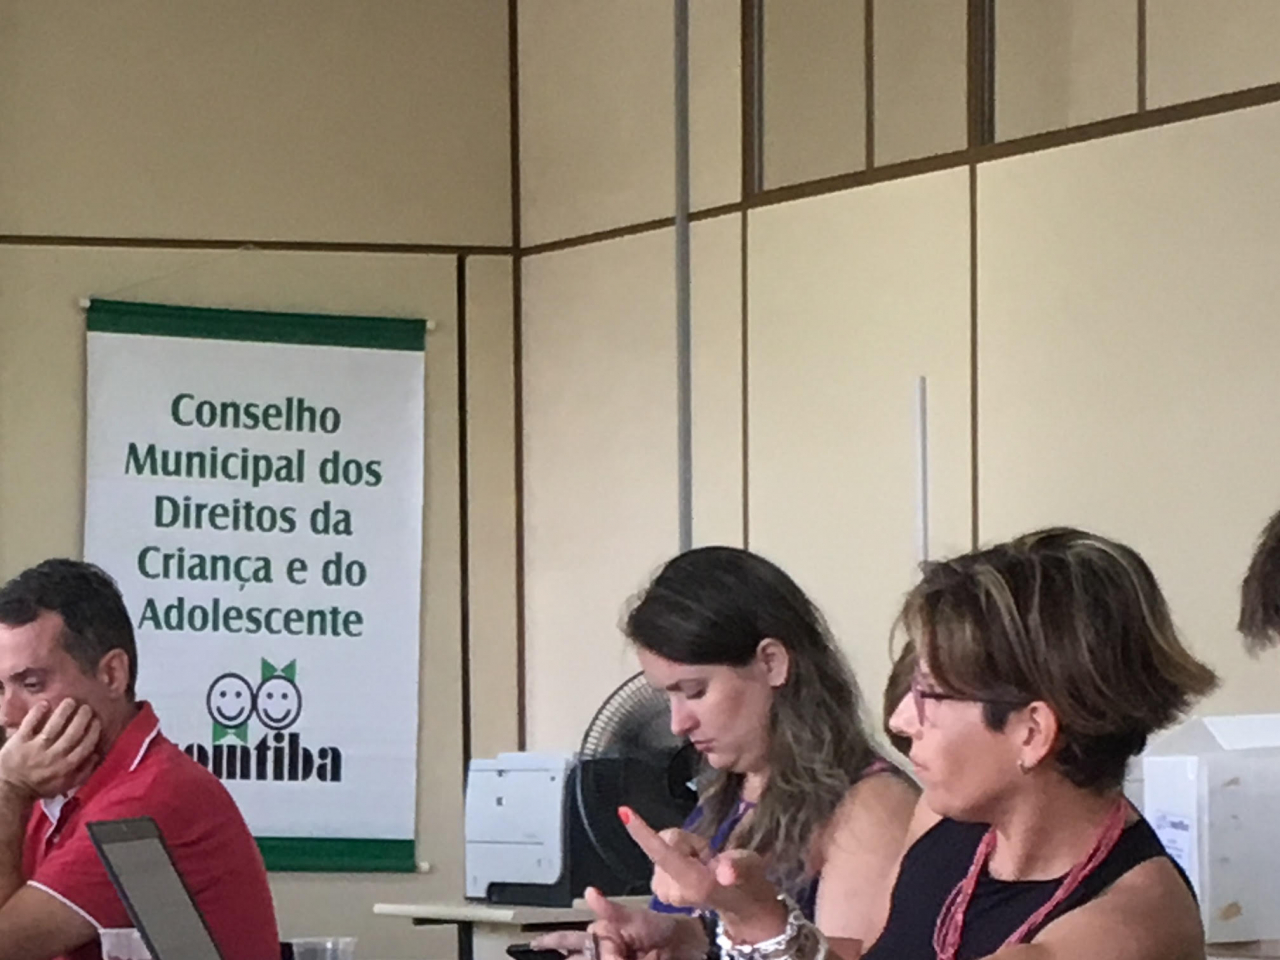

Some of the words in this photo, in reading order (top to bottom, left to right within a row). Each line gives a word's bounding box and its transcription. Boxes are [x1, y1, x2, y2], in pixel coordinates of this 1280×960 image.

[172, 392, 341, 434] Conselho
[125, 443, 305, 488] Municipal
[319, 450, 383, 487] dos
[155, 495, 297, 534] Direitos
[310, 501, 353, 536] da
[137, 545, 273, 591] Criança
[286, 558, 308, 586] e
[322, 551, 367, 587] do
[138, 597, 363, 637] Adolescente
[184, 731, 342, 782] omtiba
